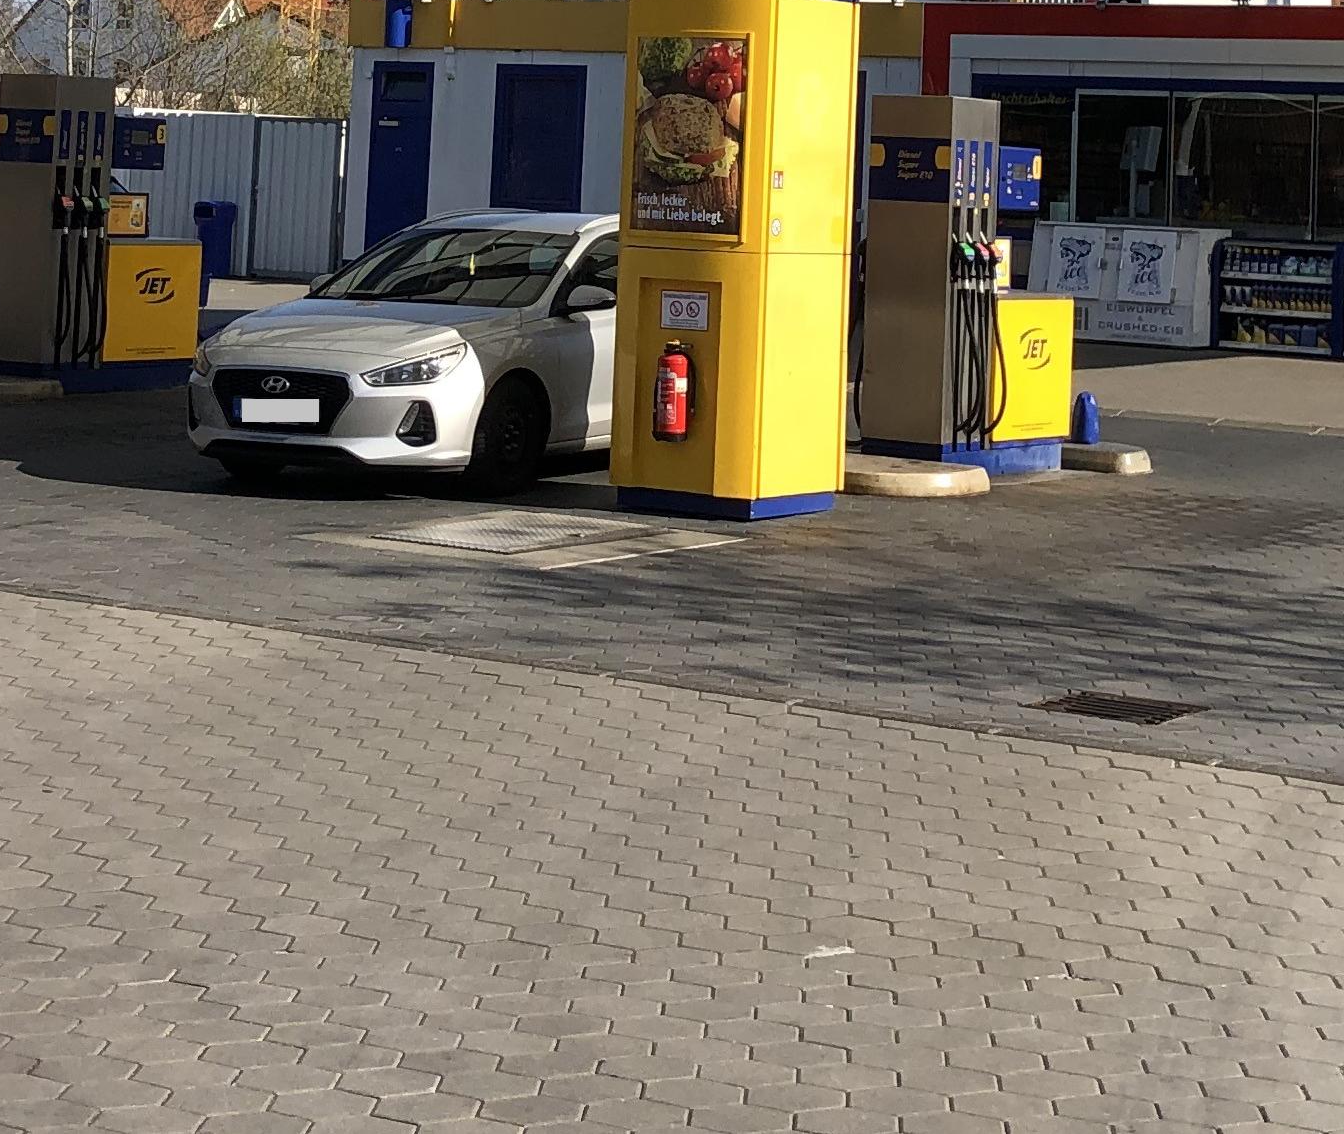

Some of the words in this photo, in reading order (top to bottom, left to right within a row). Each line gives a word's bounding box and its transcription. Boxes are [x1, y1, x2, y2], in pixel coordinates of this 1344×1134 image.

[661, 193, 687, 207] lecker
[666, 207, 690, 221] Liebe
[691, 209, 724, 226] belegt.
[139, 277, 171, 295] JET
[1023, 338, 1048, 360] JET
